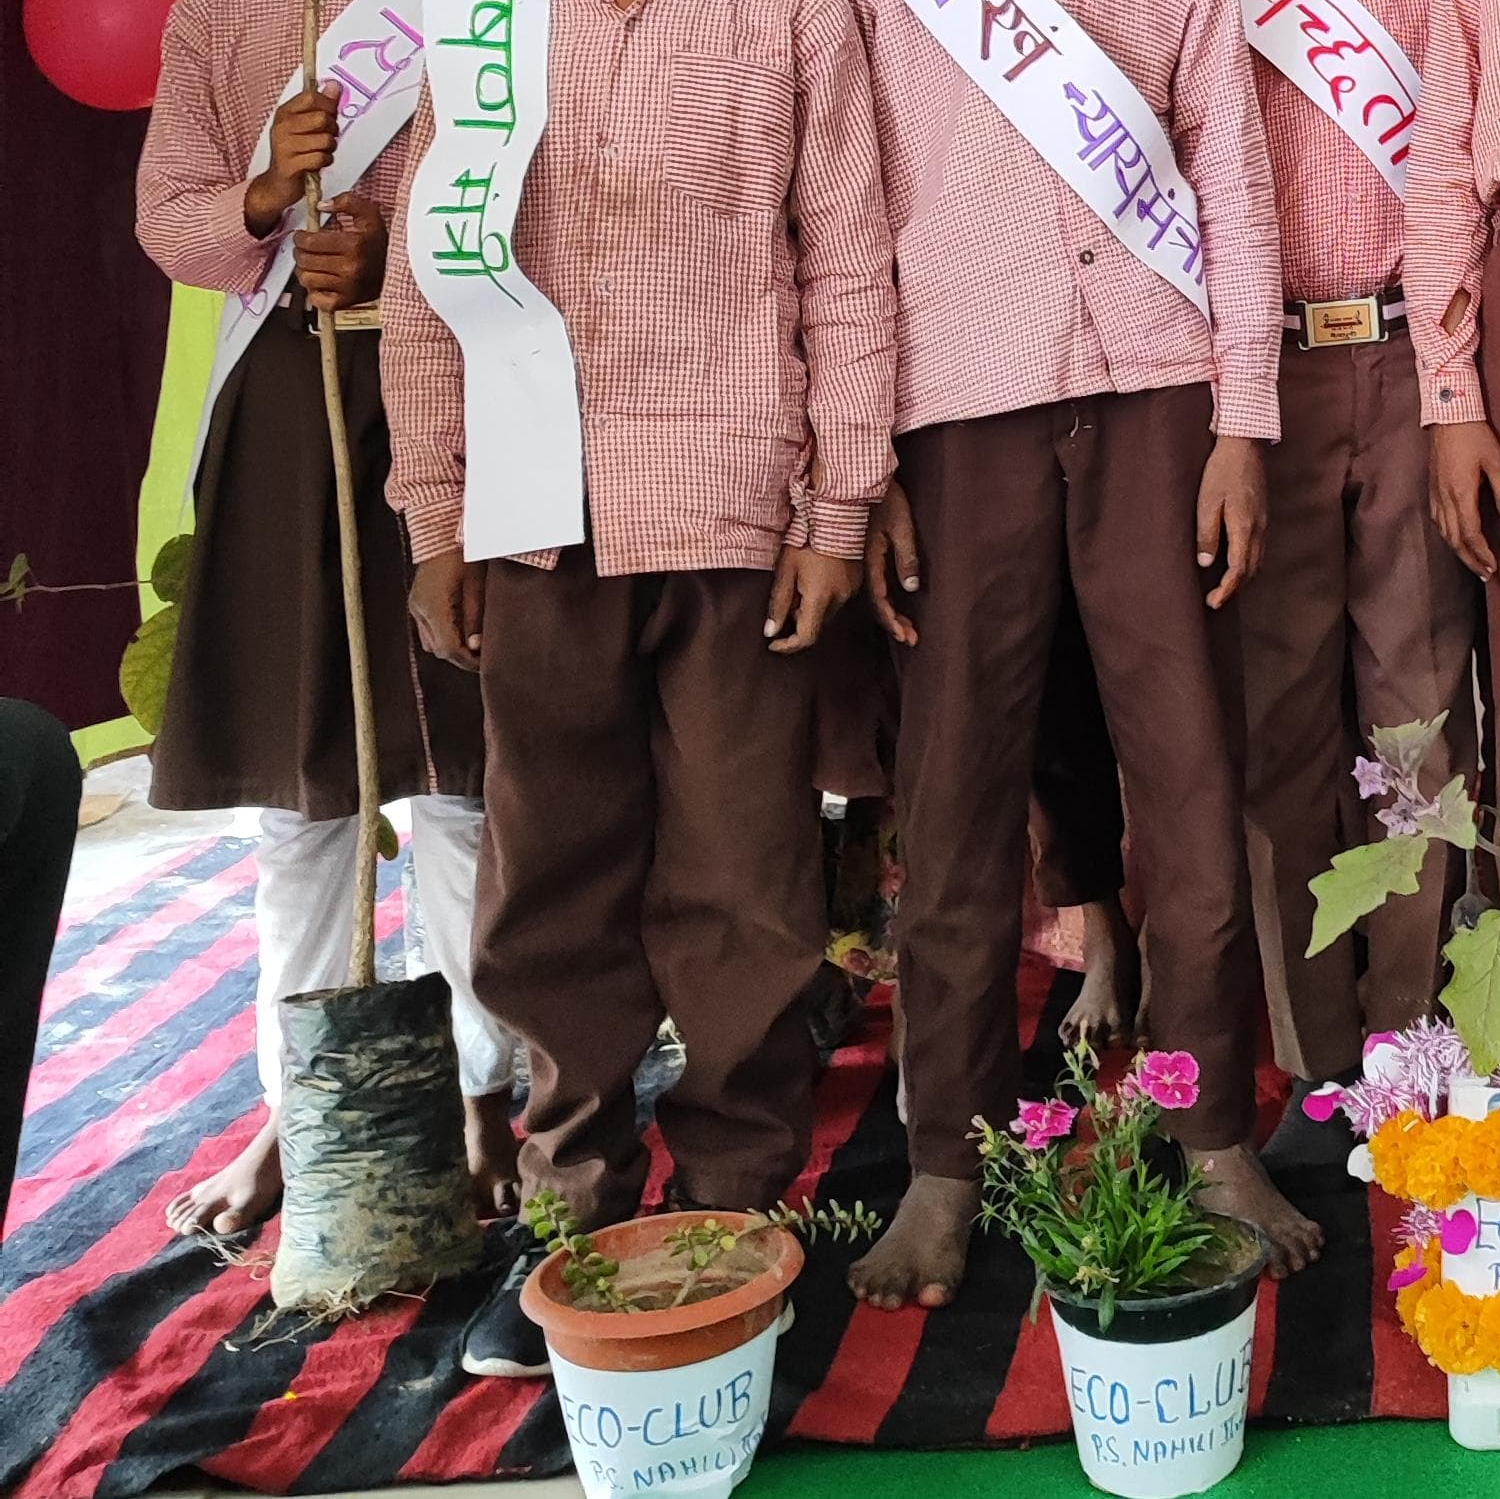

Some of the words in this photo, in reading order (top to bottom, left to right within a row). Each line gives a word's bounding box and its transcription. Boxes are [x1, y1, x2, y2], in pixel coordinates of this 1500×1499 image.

[427, 161, 526, 309] मंत्री
[562, 1369, 753, 1449] ECO-CLUB
[632, 1446, 736, 1491] NAHILI
[1132, 1428, 1214, 1466] NAHILI
